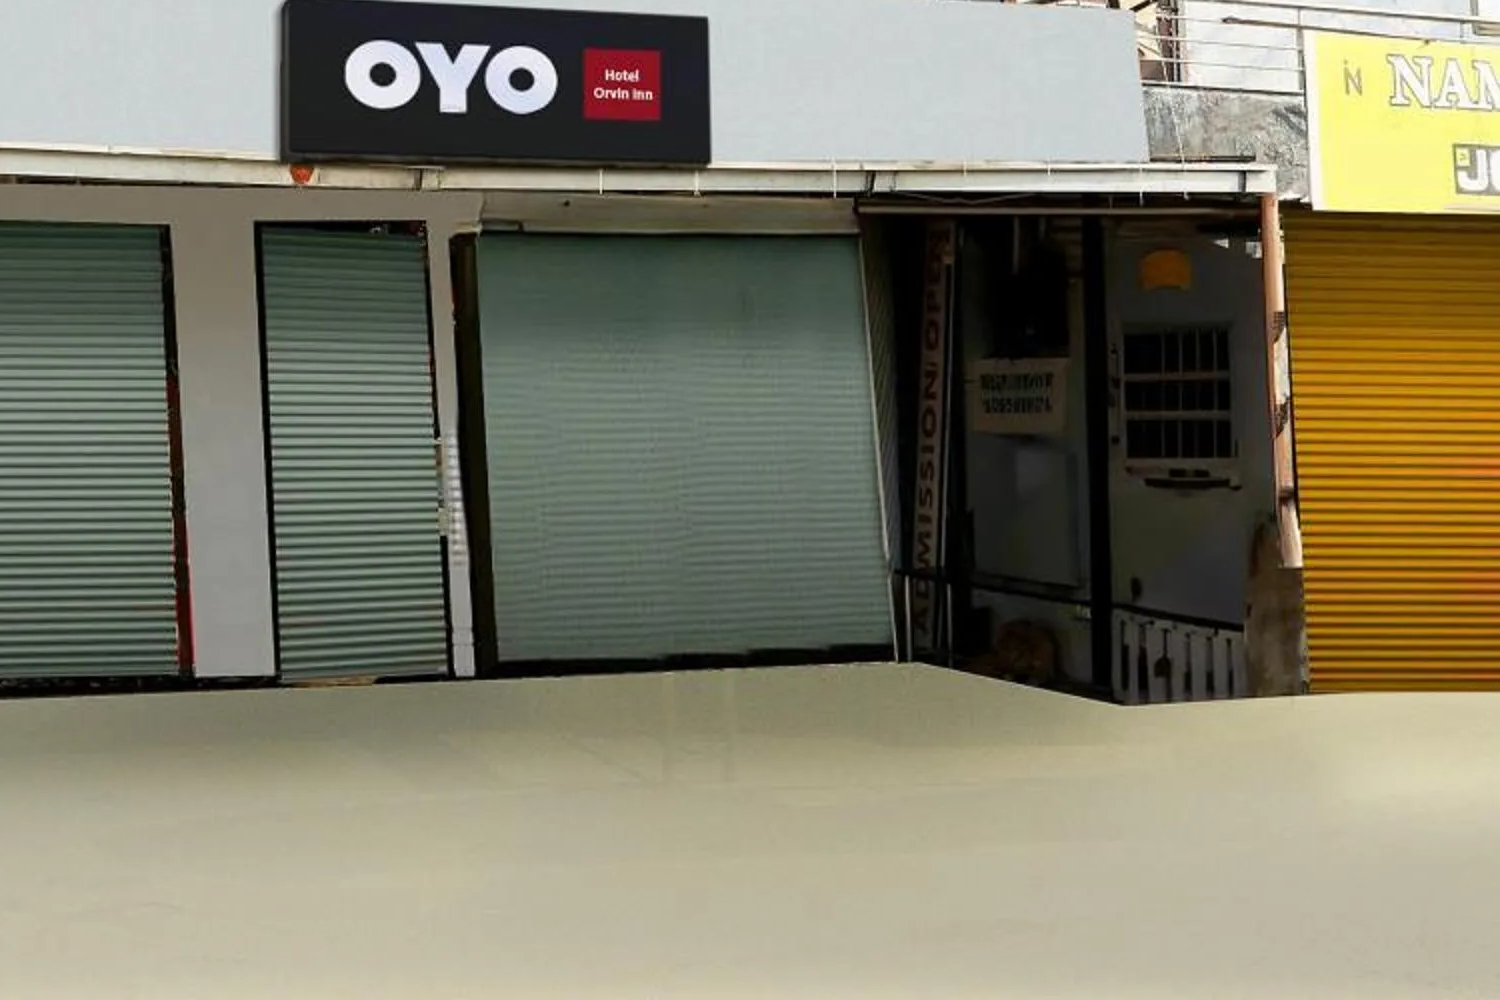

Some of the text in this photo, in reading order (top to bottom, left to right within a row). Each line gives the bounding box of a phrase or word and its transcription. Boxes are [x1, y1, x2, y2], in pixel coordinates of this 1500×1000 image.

[344, 39, 558, 115] OYO
[605, 68, 640, 82] Hotel
[593, 87, 629, 100] Orvin
